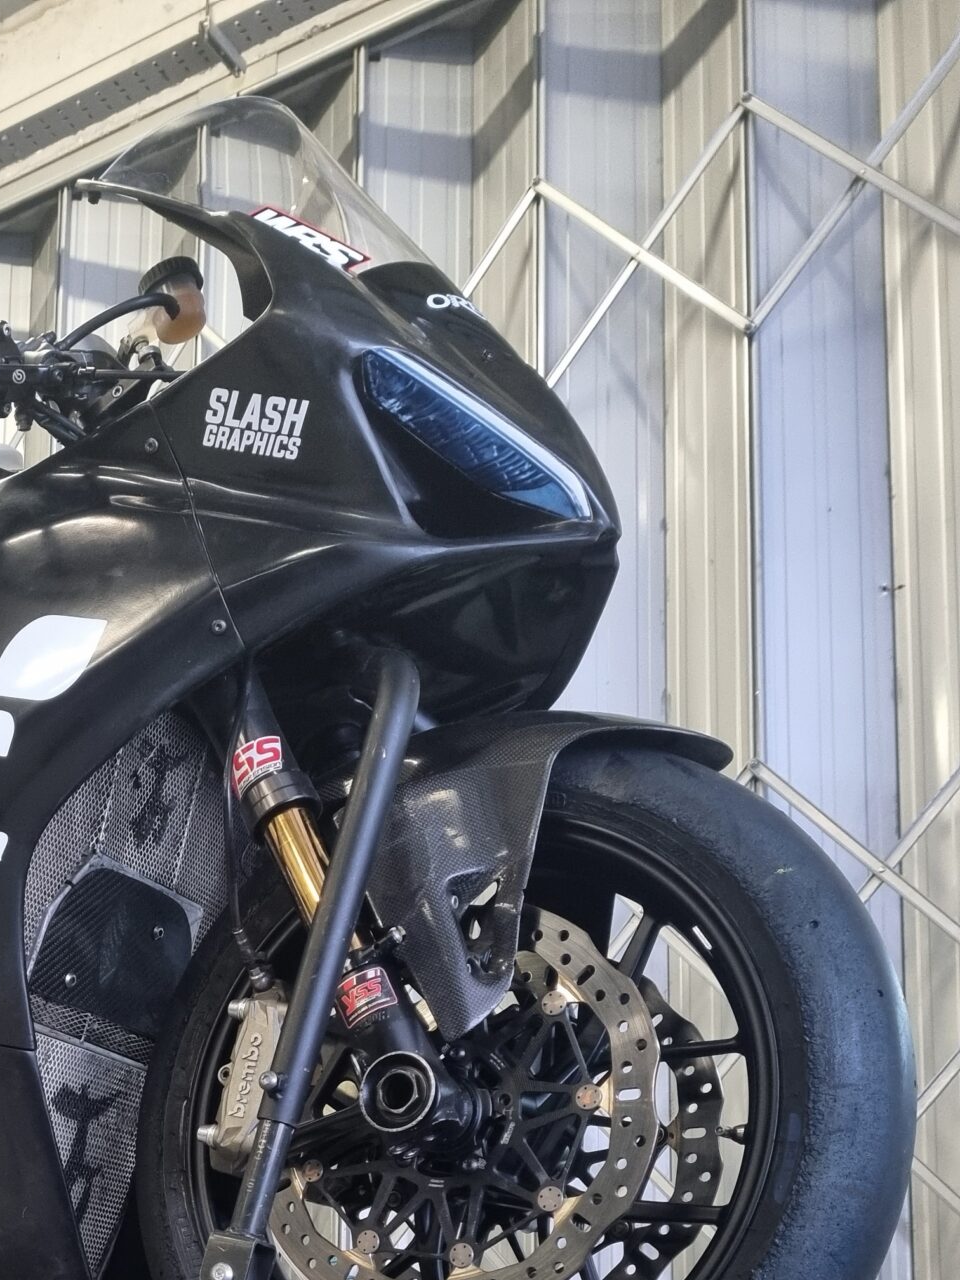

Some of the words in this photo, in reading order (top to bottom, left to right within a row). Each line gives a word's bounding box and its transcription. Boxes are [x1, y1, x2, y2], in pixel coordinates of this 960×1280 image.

[253, 208, 364, 268] WRS
[205, 387, 310, 437] SLASH
[202, 424, 302, 460] GRAPHICS
[233, 737, 282, 785] SS
[228, 1032, 262, 1118] brembo
